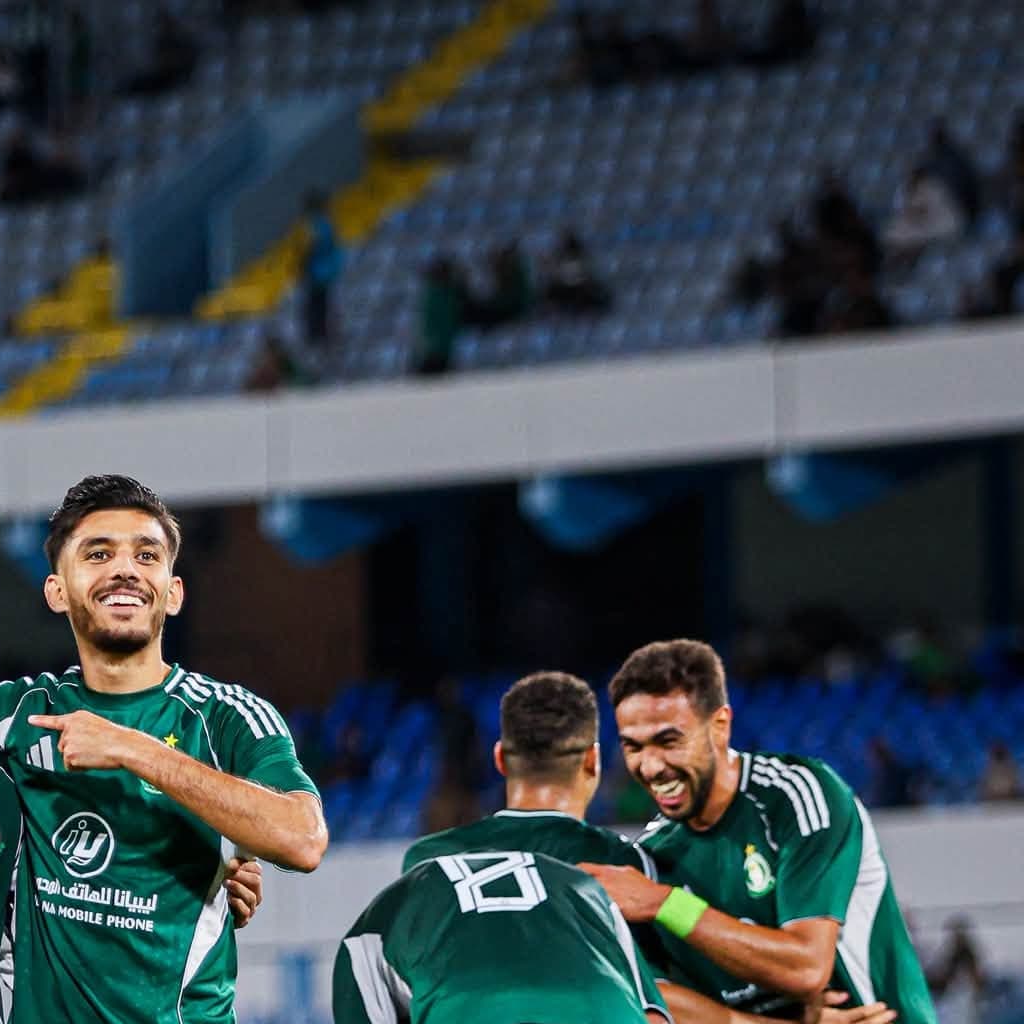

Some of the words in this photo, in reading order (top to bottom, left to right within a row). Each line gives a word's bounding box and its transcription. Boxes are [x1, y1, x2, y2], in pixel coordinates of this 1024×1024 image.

[62, 882, 111, 905] للهاتف
[113, 888, 158, 915] ليبيانا
[58, 905, 103, 925] MOBILE
[106, 914, 154, 932] PHONE
